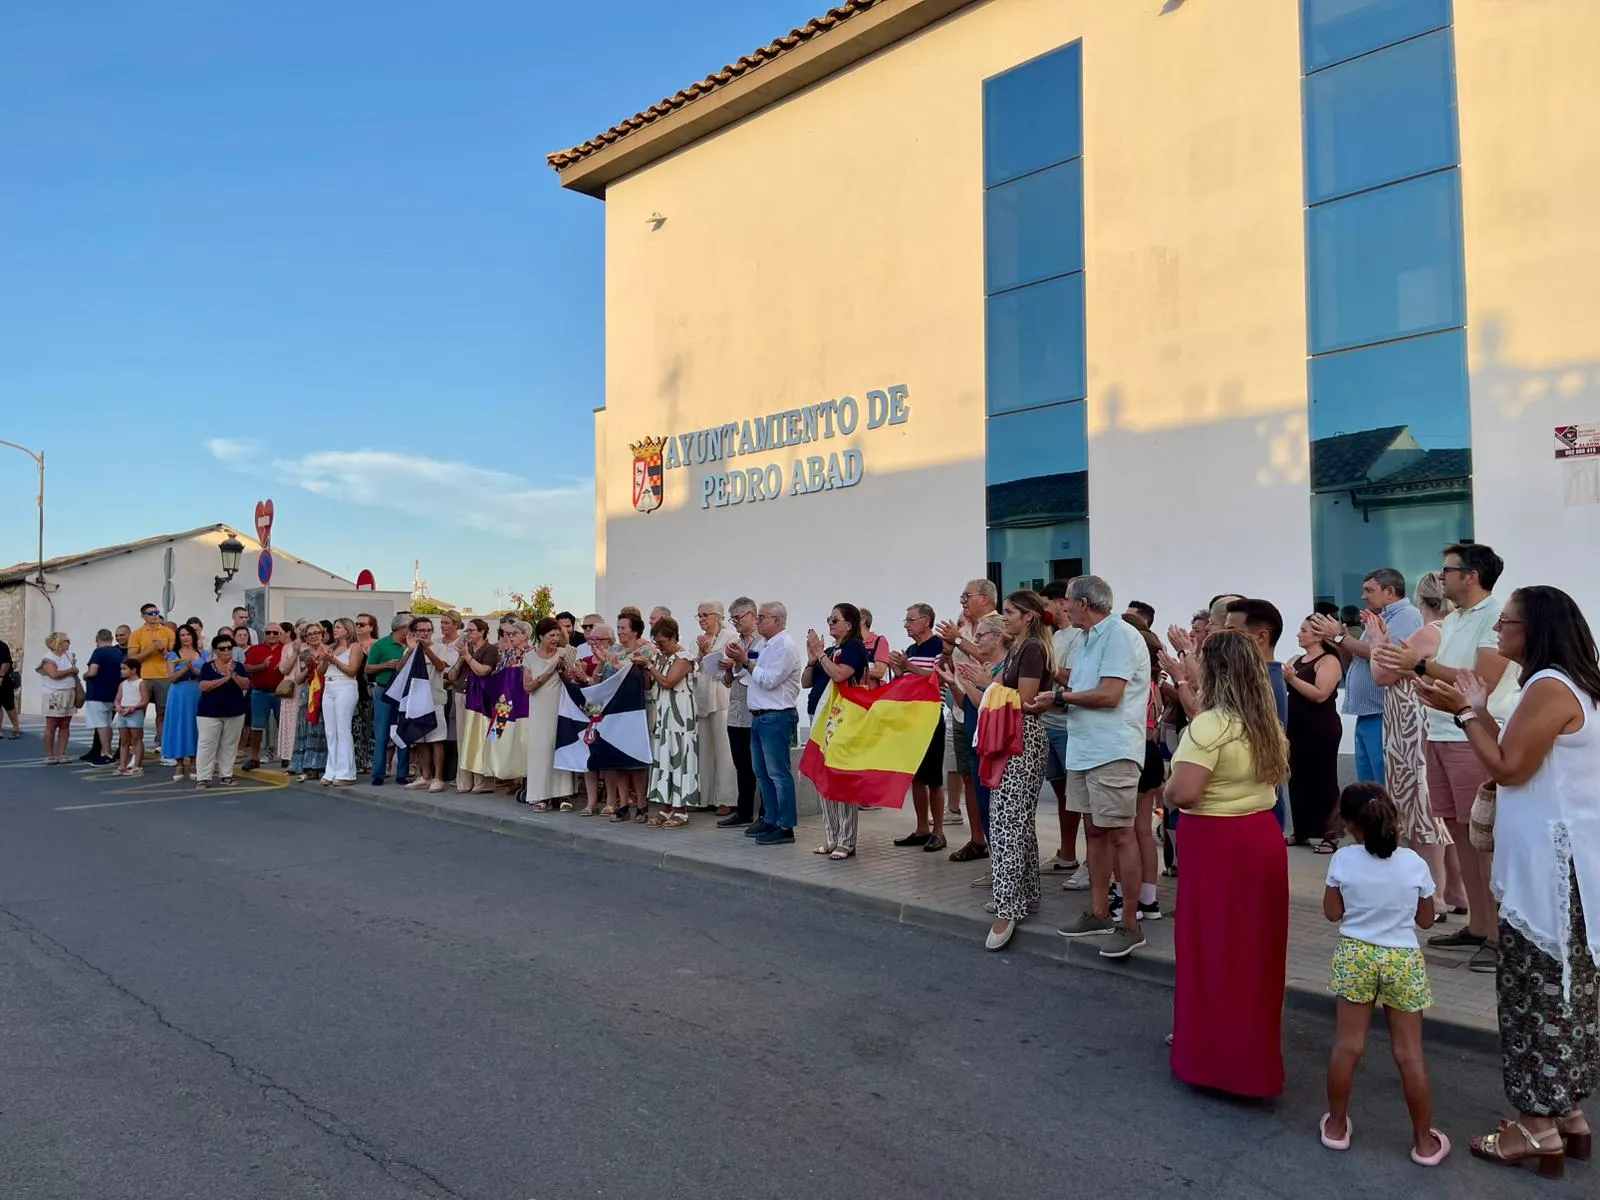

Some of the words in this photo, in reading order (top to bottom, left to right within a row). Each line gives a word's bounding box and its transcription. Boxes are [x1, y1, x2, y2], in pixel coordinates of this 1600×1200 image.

[665, 396, 859, 469] AYUNTAMIENTO
[866, 384, 910, 429] DE
[701, 463, 782, 509] PEDRO
[790, 448, 864, 496] ABAD
